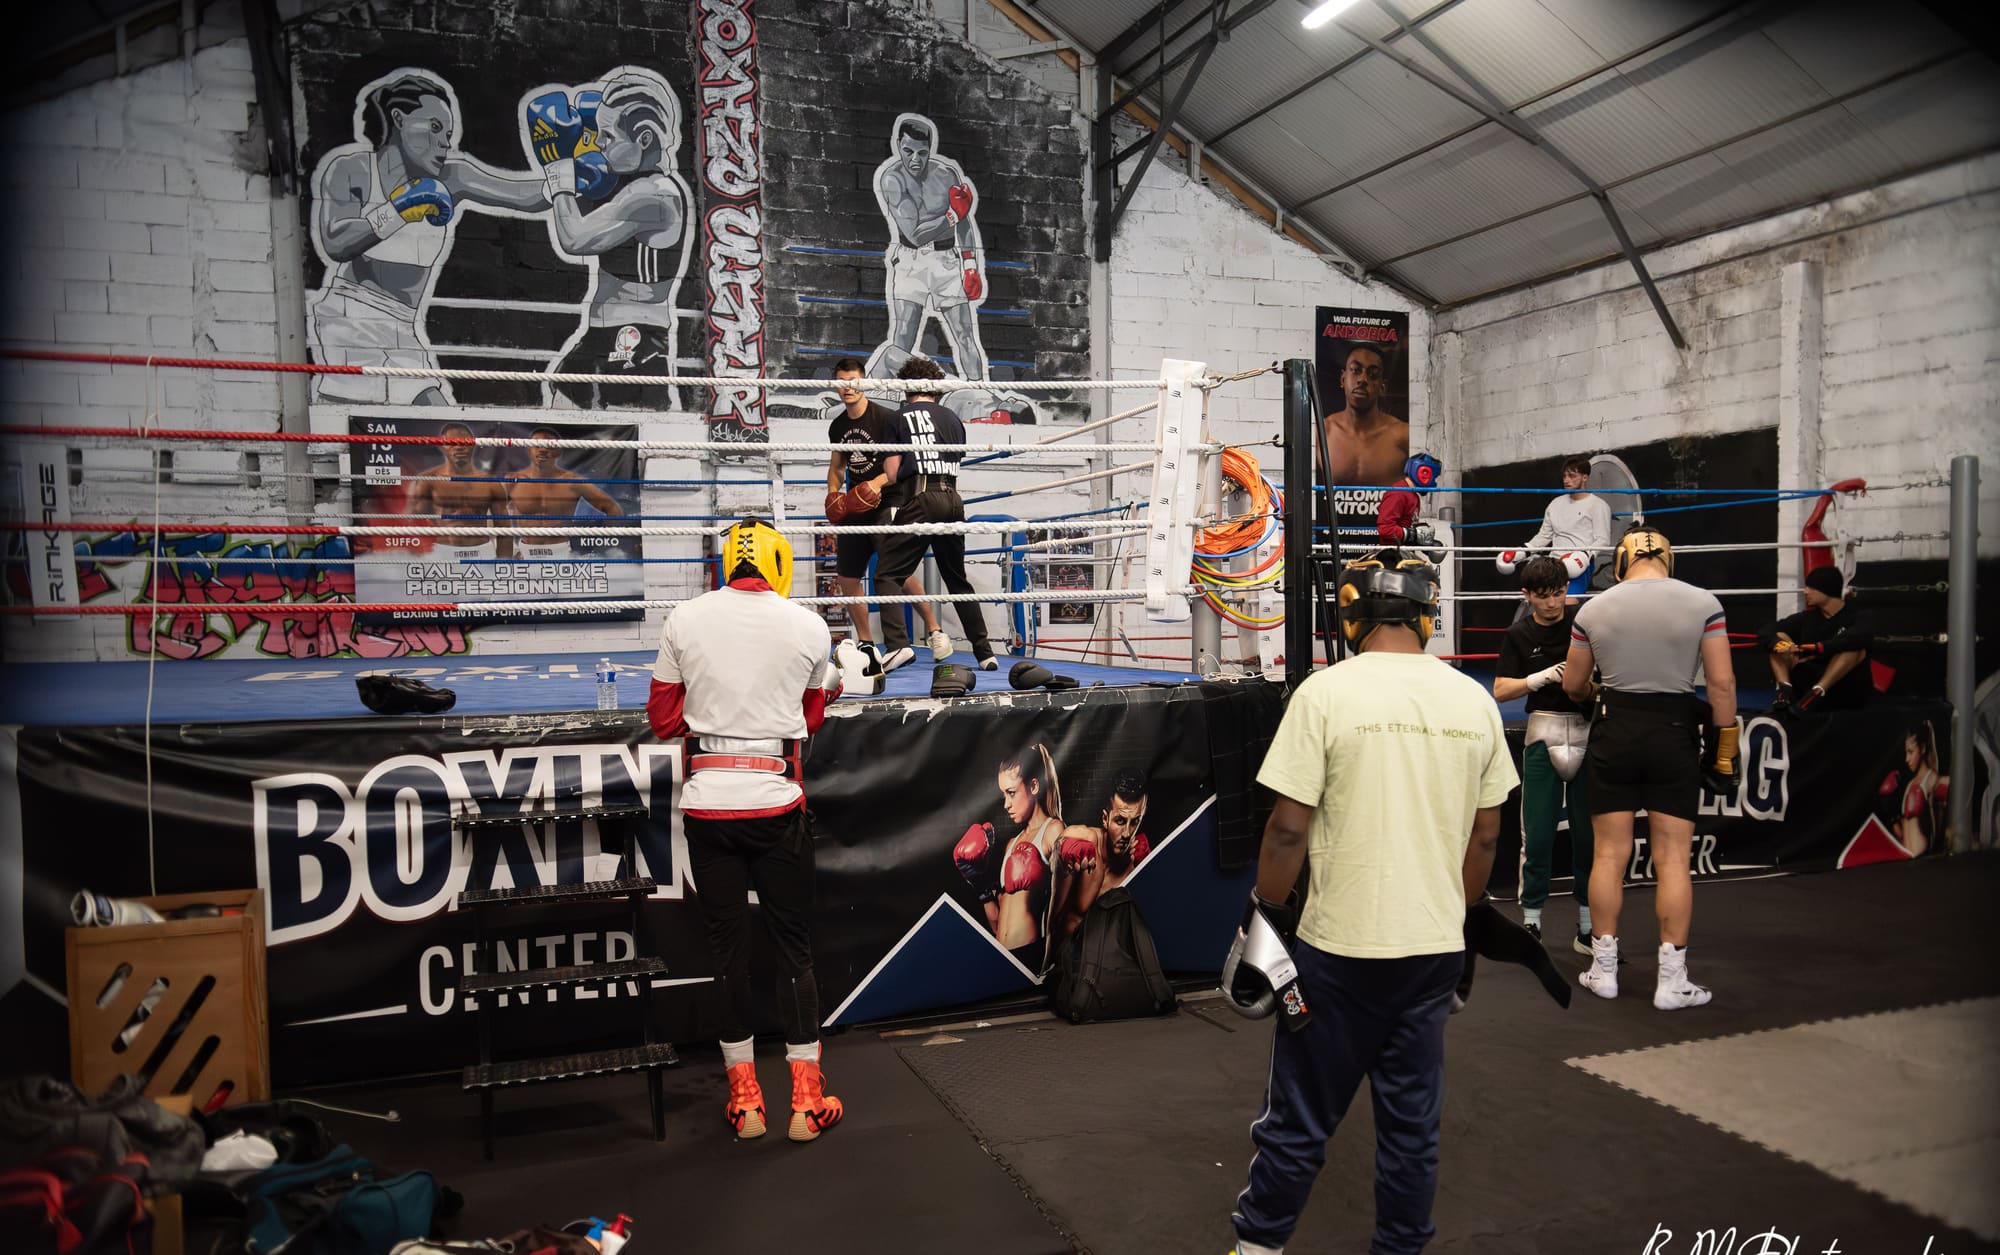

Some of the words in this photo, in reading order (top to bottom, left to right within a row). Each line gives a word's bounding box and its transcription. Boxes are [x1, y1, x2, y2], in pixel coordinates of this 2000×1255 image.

[1333, 315, 1350, 323] WBA
[1352, 316, 1381, 325] FUTURE
[367, 423, 397, 434] SAM
[369, 454, 394, 464] JAN
[1335, 501, 1381, 515] KITOK
[385, 537, 421, 547] SUFFO
[580, 537, 619, 547] KITOKO
[407, 563, 484, 580] GALA
[494, 563, 529, 580] DE
[541, 563, 607, 580] BOXE
[406, 579, 608, 596] PROFESSIONNELLE
[393, 610, 438, 618] BOXING
[1354, 723, 1382, 735] THIS
[1388, 723, 1437, 736] ETERNAL
[1442, 728, 1486, 741] MOMENT
[253, 744, 698, 947] BOXIN
